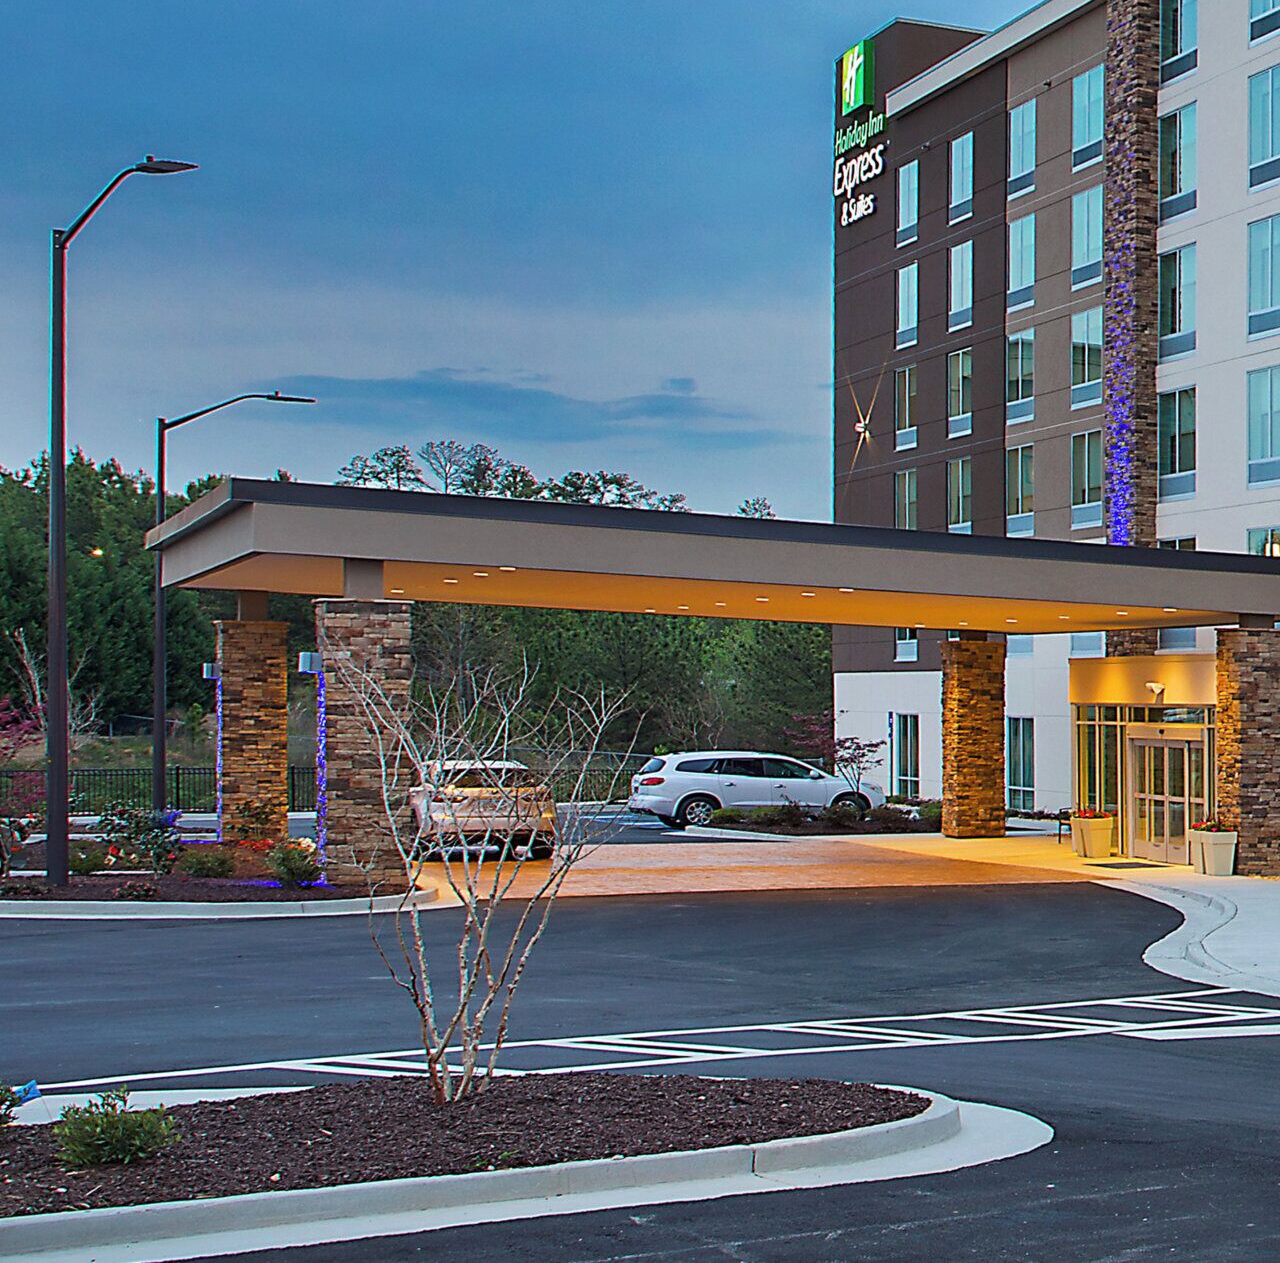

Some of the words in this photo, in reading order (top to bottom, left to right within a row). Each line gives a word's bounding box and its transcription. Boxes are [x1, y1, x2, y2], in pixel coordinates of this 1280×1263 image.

[835, 122, 867, 156] Holiday
[868, 110, 884, 138] Inn
[834, 143, 884, 198] Express
[841, 202, 849, 227] &
[849, 192, 874, 223] Suites
